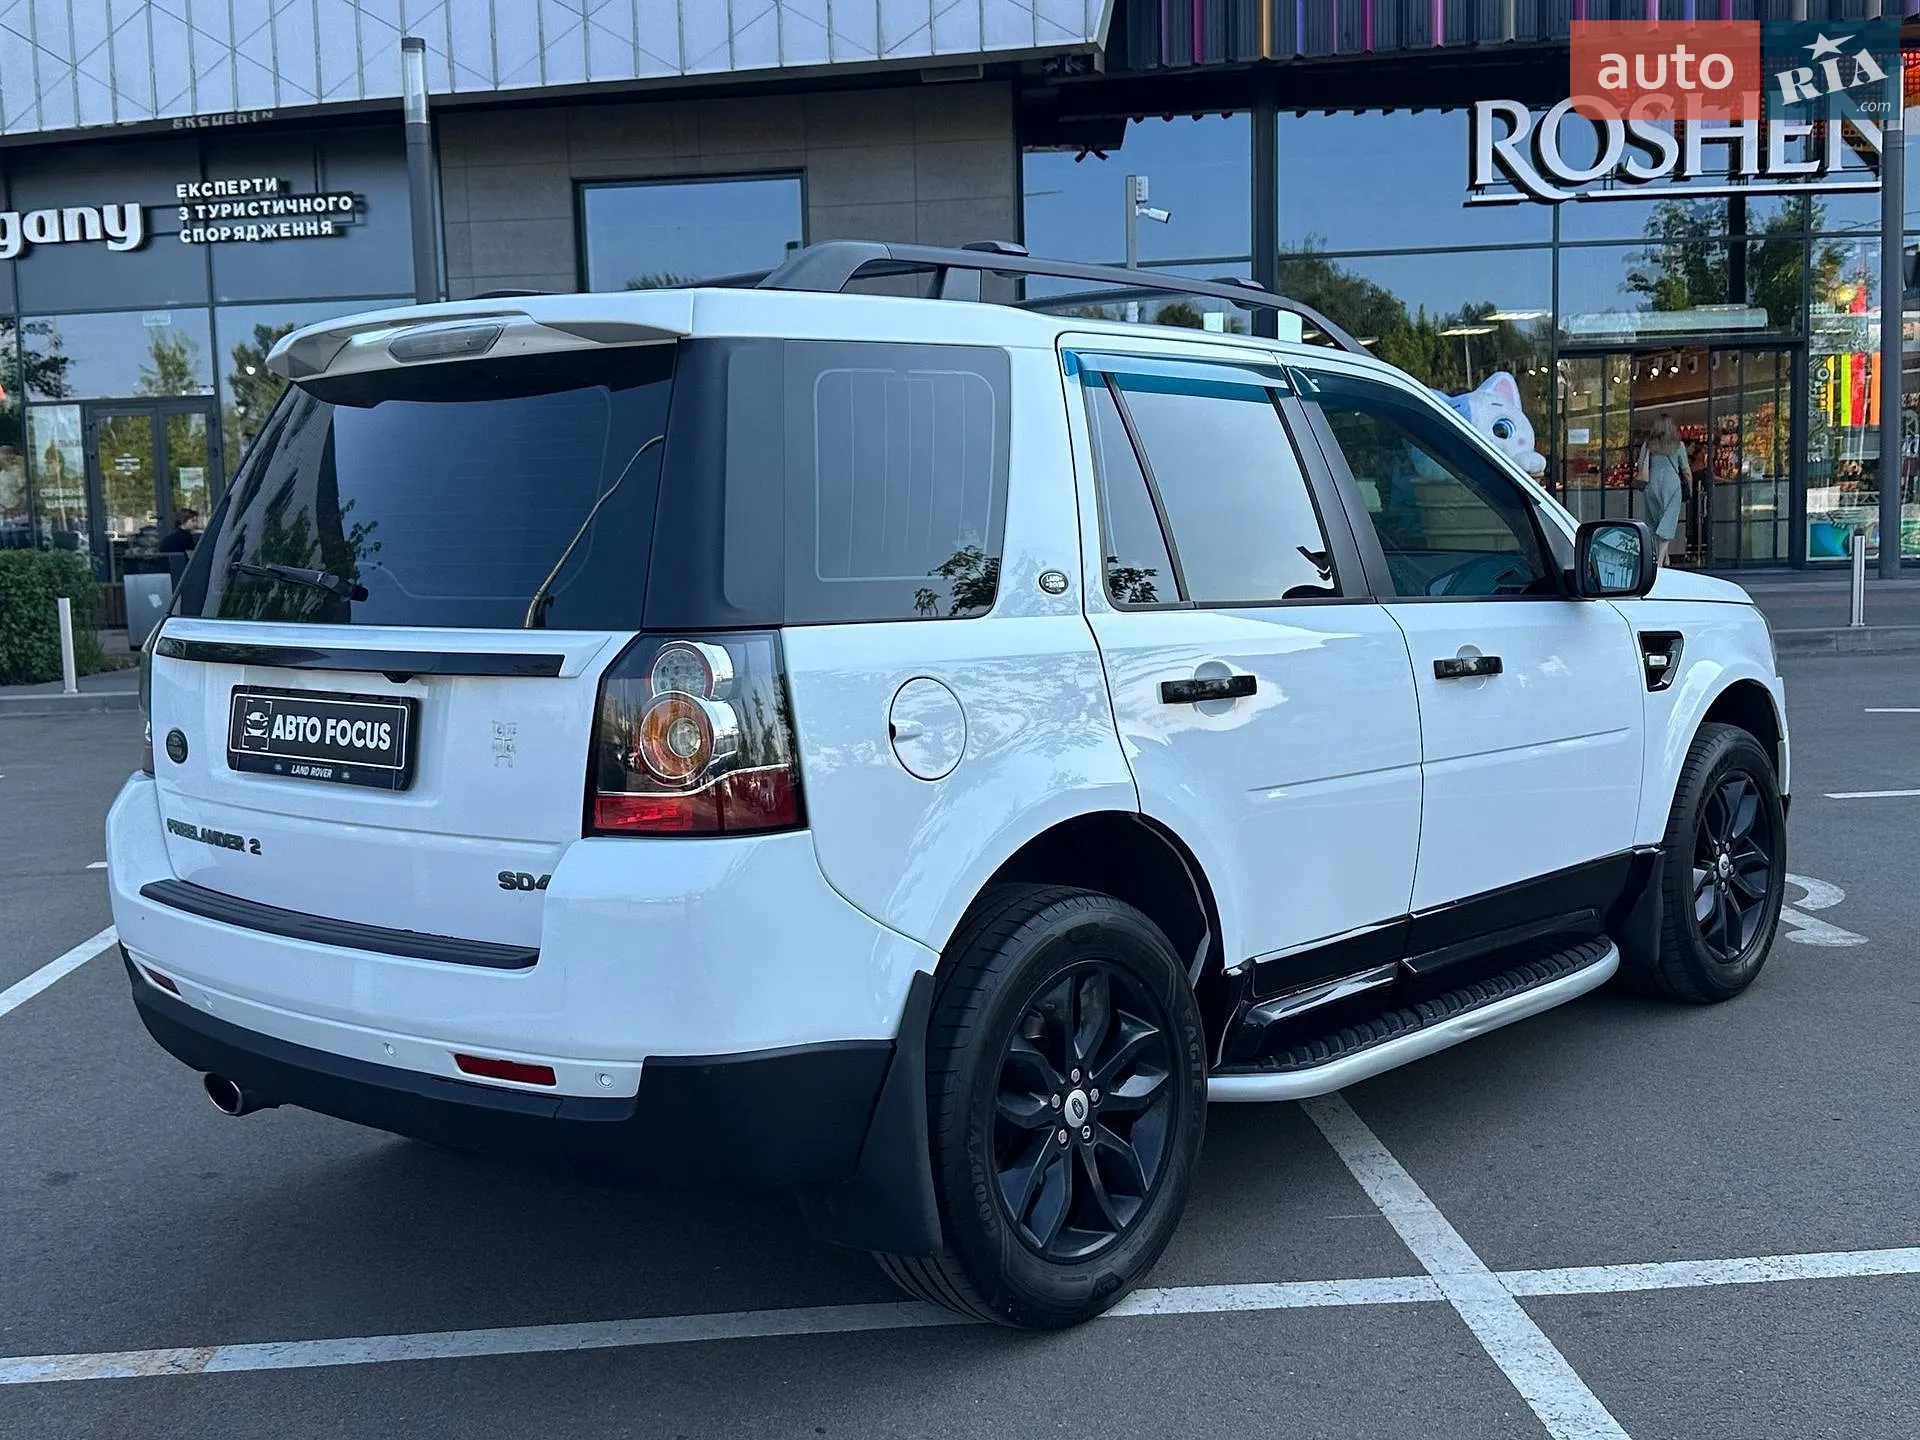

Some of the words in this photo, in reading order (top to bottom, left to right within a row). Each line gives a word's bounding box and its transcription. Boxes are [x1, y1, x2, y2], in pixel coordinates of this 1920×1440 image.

[176, 177, 278, 198] ЕКСПЕРТИ
[197, 196, 353, 220] ТУРИСТИЧНОГО
[180, 221, 333, 244] СПОРЯДЖЕННЯ
[325, 719, 391, 750] FOCUS
[291, 765, 309, 777] LAND
[310, 767, 333, 779] ROVER
[249, 838, 262, 855] 2
[498, 871, 552, 891] SD4
